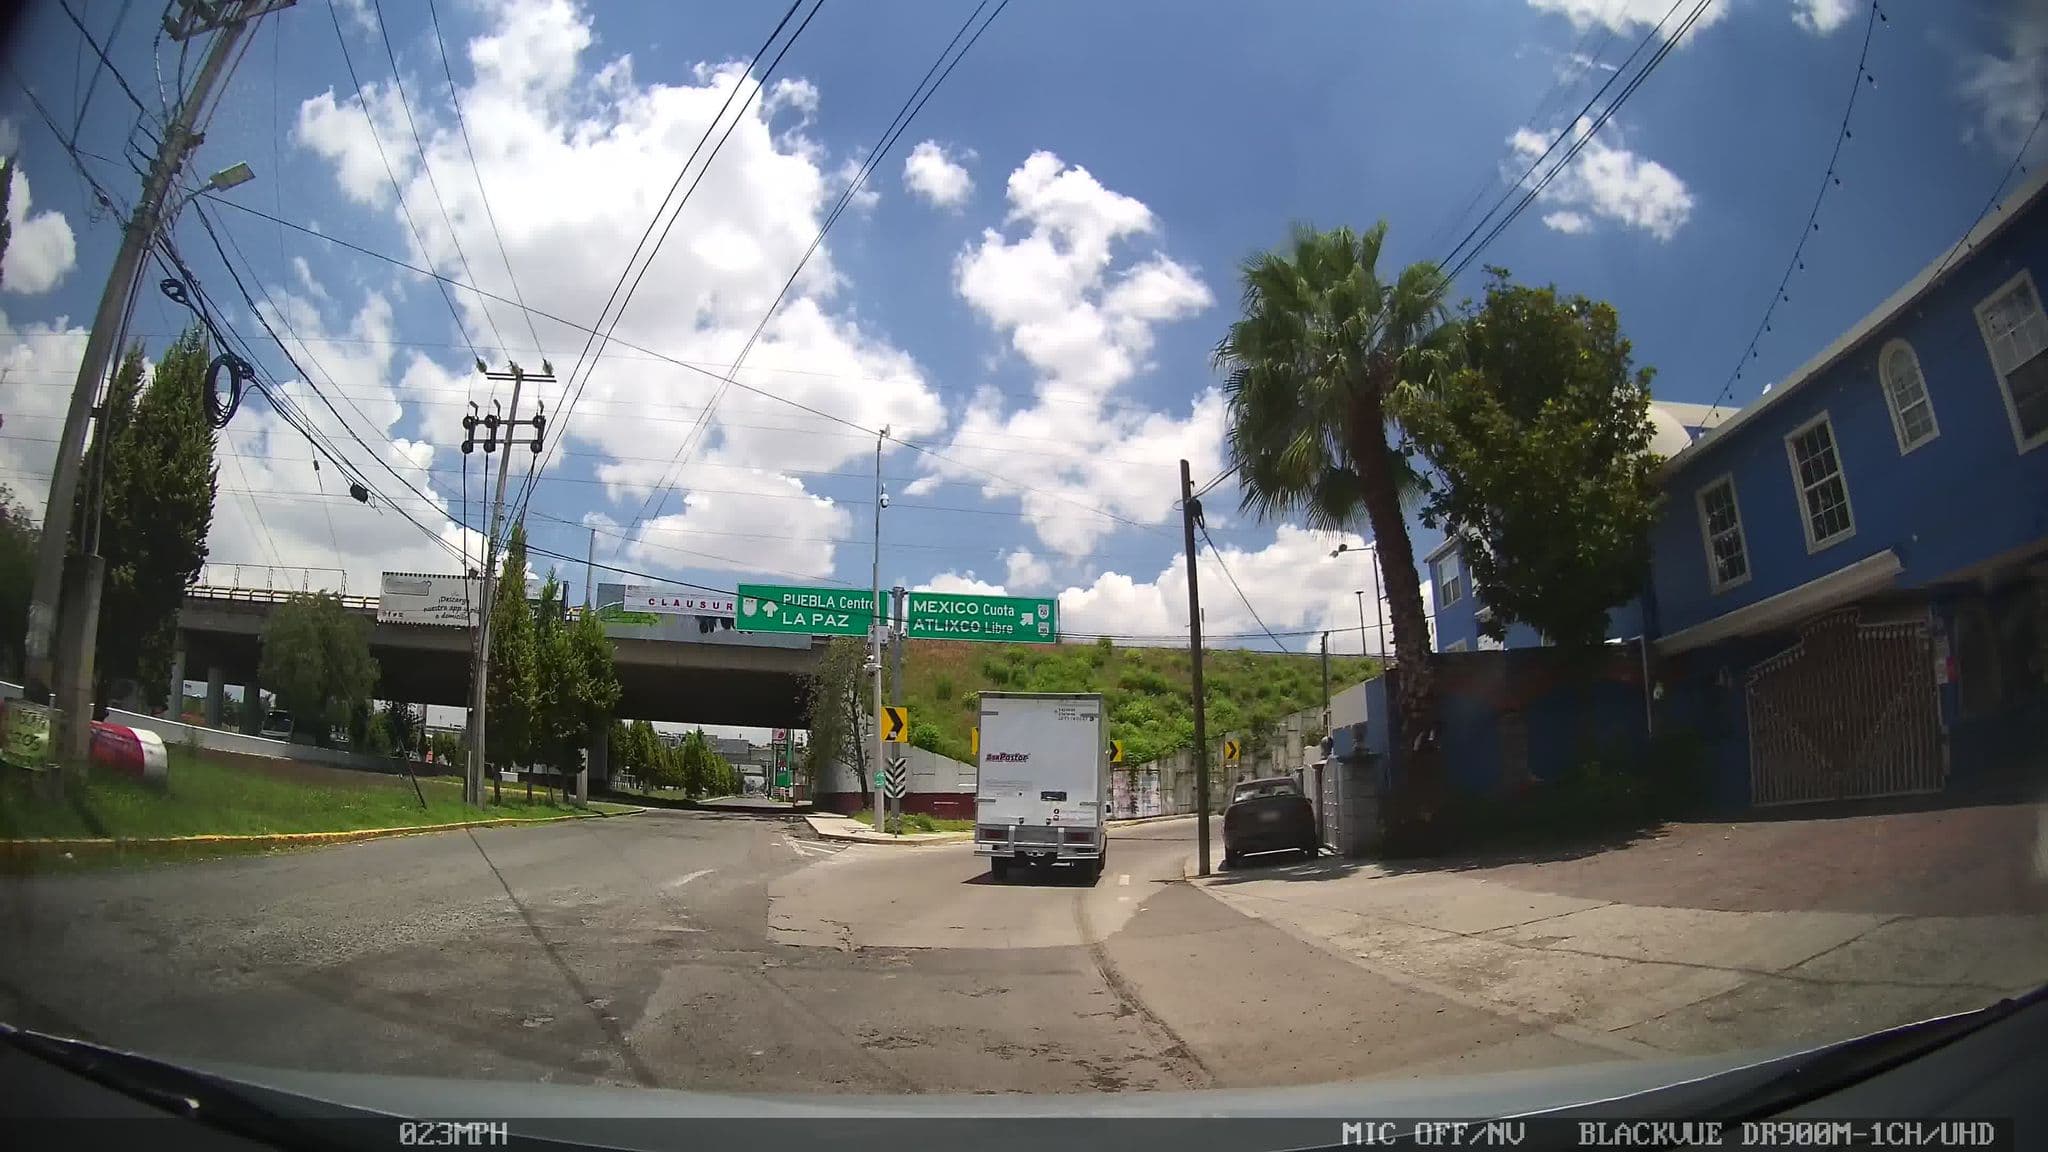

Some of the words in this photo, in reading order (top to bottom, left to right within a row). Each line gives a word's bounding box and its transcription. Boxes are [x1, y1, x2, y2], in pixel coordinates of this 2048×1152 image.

[648, 598, 733, 611] CLAUSUR
[782, 593, 836, 608] PUEBLA
[913, 600, 979, 615] MEXICO
[983, 603, 1015, 616] Cuota
[782, 612, 807, 625] LA
[812, 613, 849, 627] PAZ
[913, 618, 981, 633] ATLIXCO
[985, 621, 1014, 634] Libre
